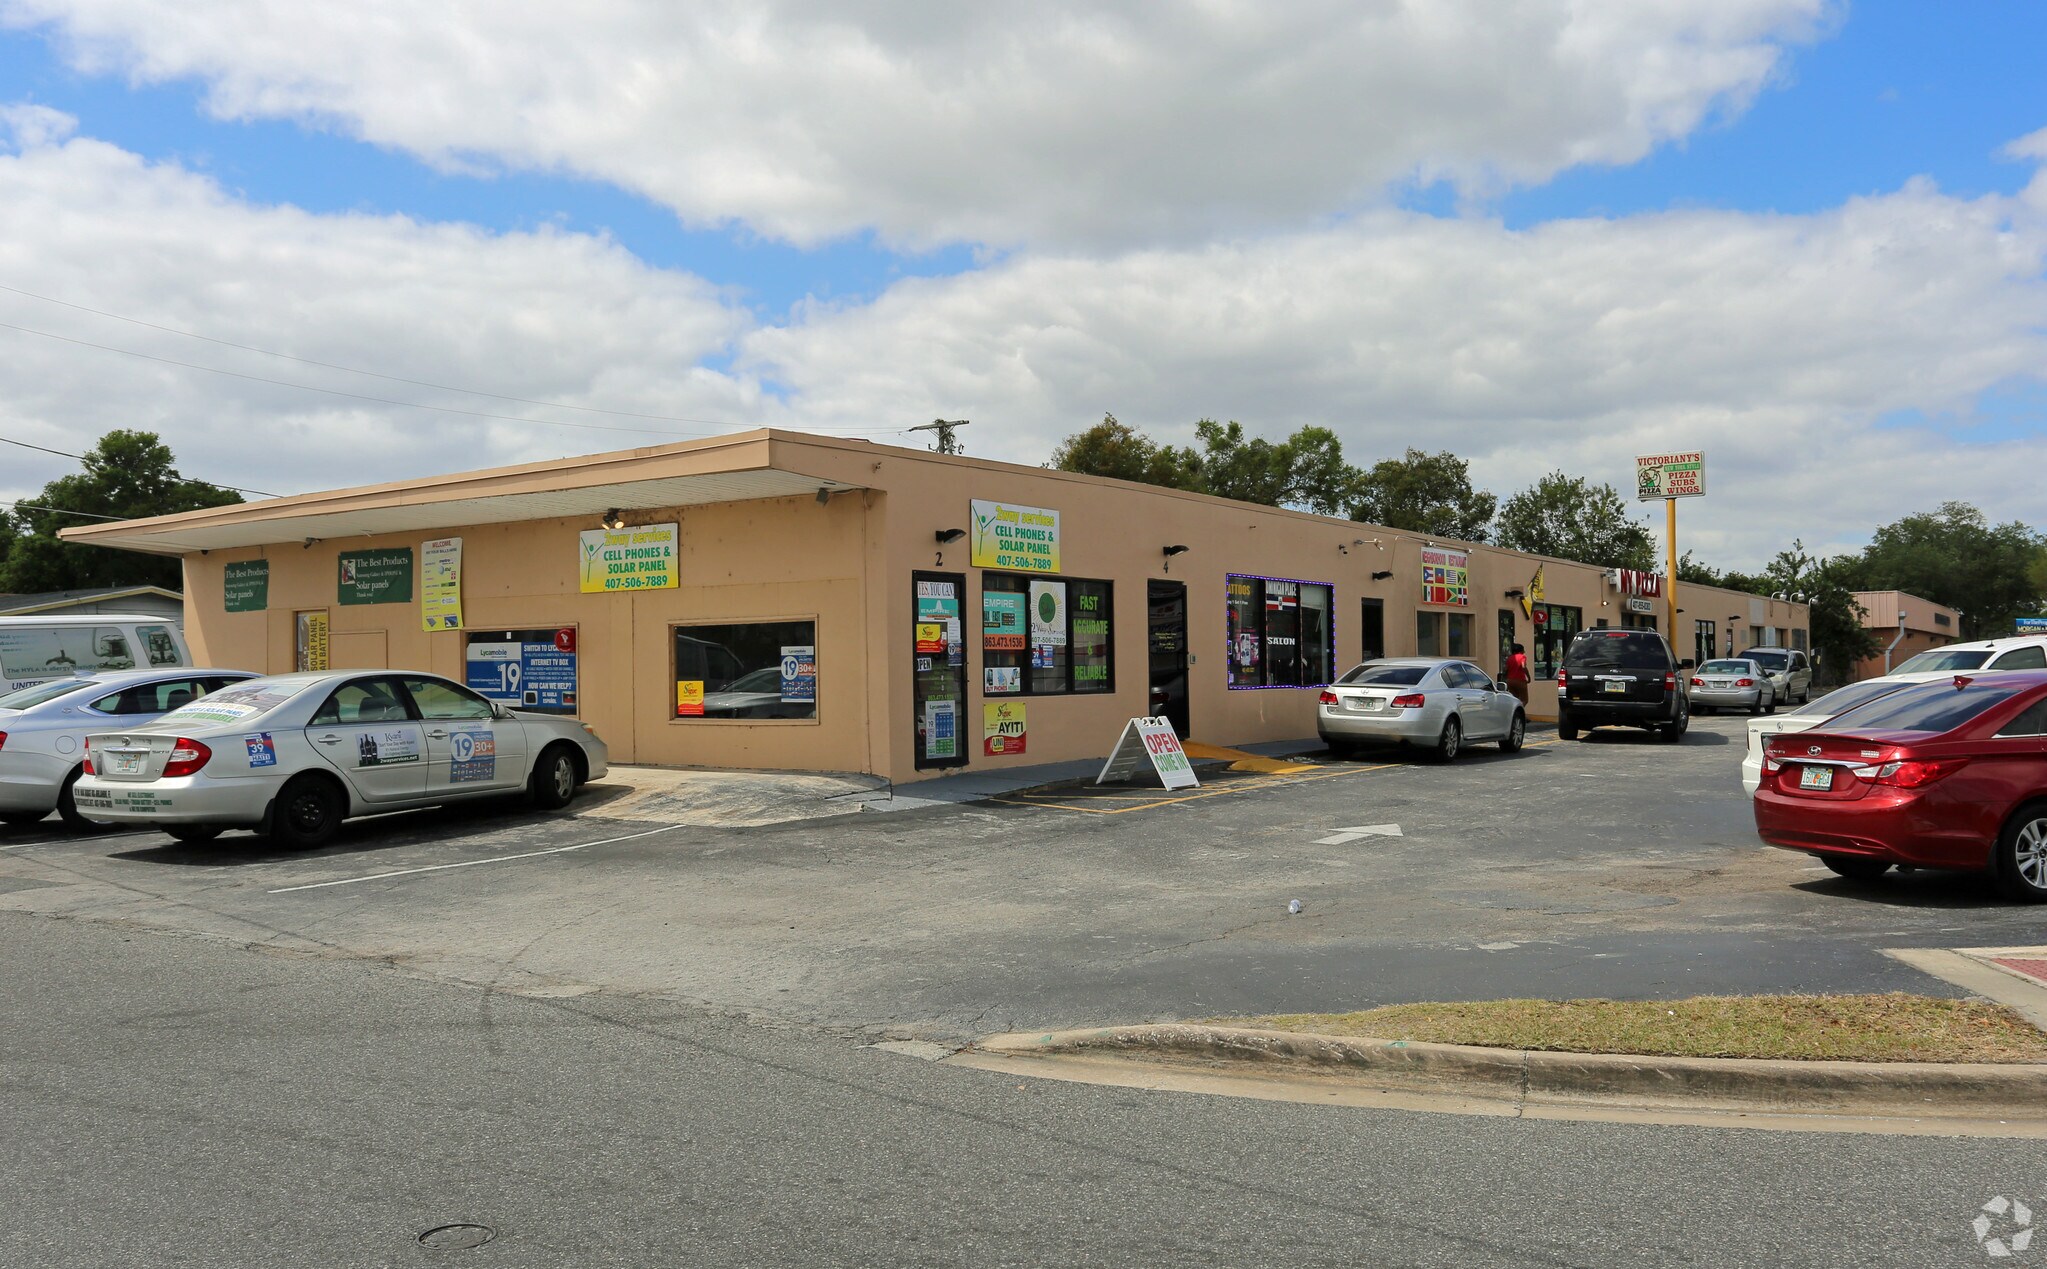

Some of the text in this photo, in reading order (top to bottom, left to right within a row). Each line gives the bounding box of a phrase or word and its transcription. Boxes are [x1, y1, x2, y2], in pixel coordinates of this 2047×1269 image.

[1638, 454, 1700, 466] VICTORIANY'S
[1668, 471, 1697, 479] PIZZA
[1666, 486, 1699, 494] WINGS
[996, 505, 1054, 527] 2way services
[604, 526, 671, 547] 2way services
[995, 525, 1054, 542] CELL PHONES &
[432, 540, 452, 548] WELCOME
[999, 540, 1050, 554] SOLAR PANEL
[603, 546, 671, 561] CELL PHONES &
[936, 552, 943, 567] 2
[357, 556, 409, 568] The Best Products
[608, 560, 667, 574] SOLAR PANEL
[997, 555, 1051, 569] 407-506-7889
[1163, 561, 1168, 574] 4
[248, 568, 268, 576] Products
[356, 580, 389, 591] Solar panels
[605, 575, 667, 589] 407-506-7889
[226, 590, 253, 600] Solar panels
[930, 583, 941, 596] YOU
[1228, 584, 1250, 595] ATTOOS
[1285, 582, 1296, 596] PLACE
[984, 599, 1014, 608] EMPIRE
[1080, 596, 1098, 610] FAST
[1074, 619, 1108, 635] ACCURATE
[984, 636, 1022, 648] 863.473.1536
[1267, 637, 1295, 646] SALON
[1088, 641, 1092, 656] &
[783, 660, 813, 676] 19 30+
[1074, 665, 1107, 680] RELIABLE
[998, 722, 1023, 734] AYITI
[251, 744, 264, 753] 39
[454, 738, 472, 757] 19
[475, 741, 493, 752] 30+
[993, 738, 1003, 746] UNI
[1146, 733, 1181, 755] OPEN
[380, 755, 417, 764] 2wayservices.net
[1155, 754, 1178, 772] COME
